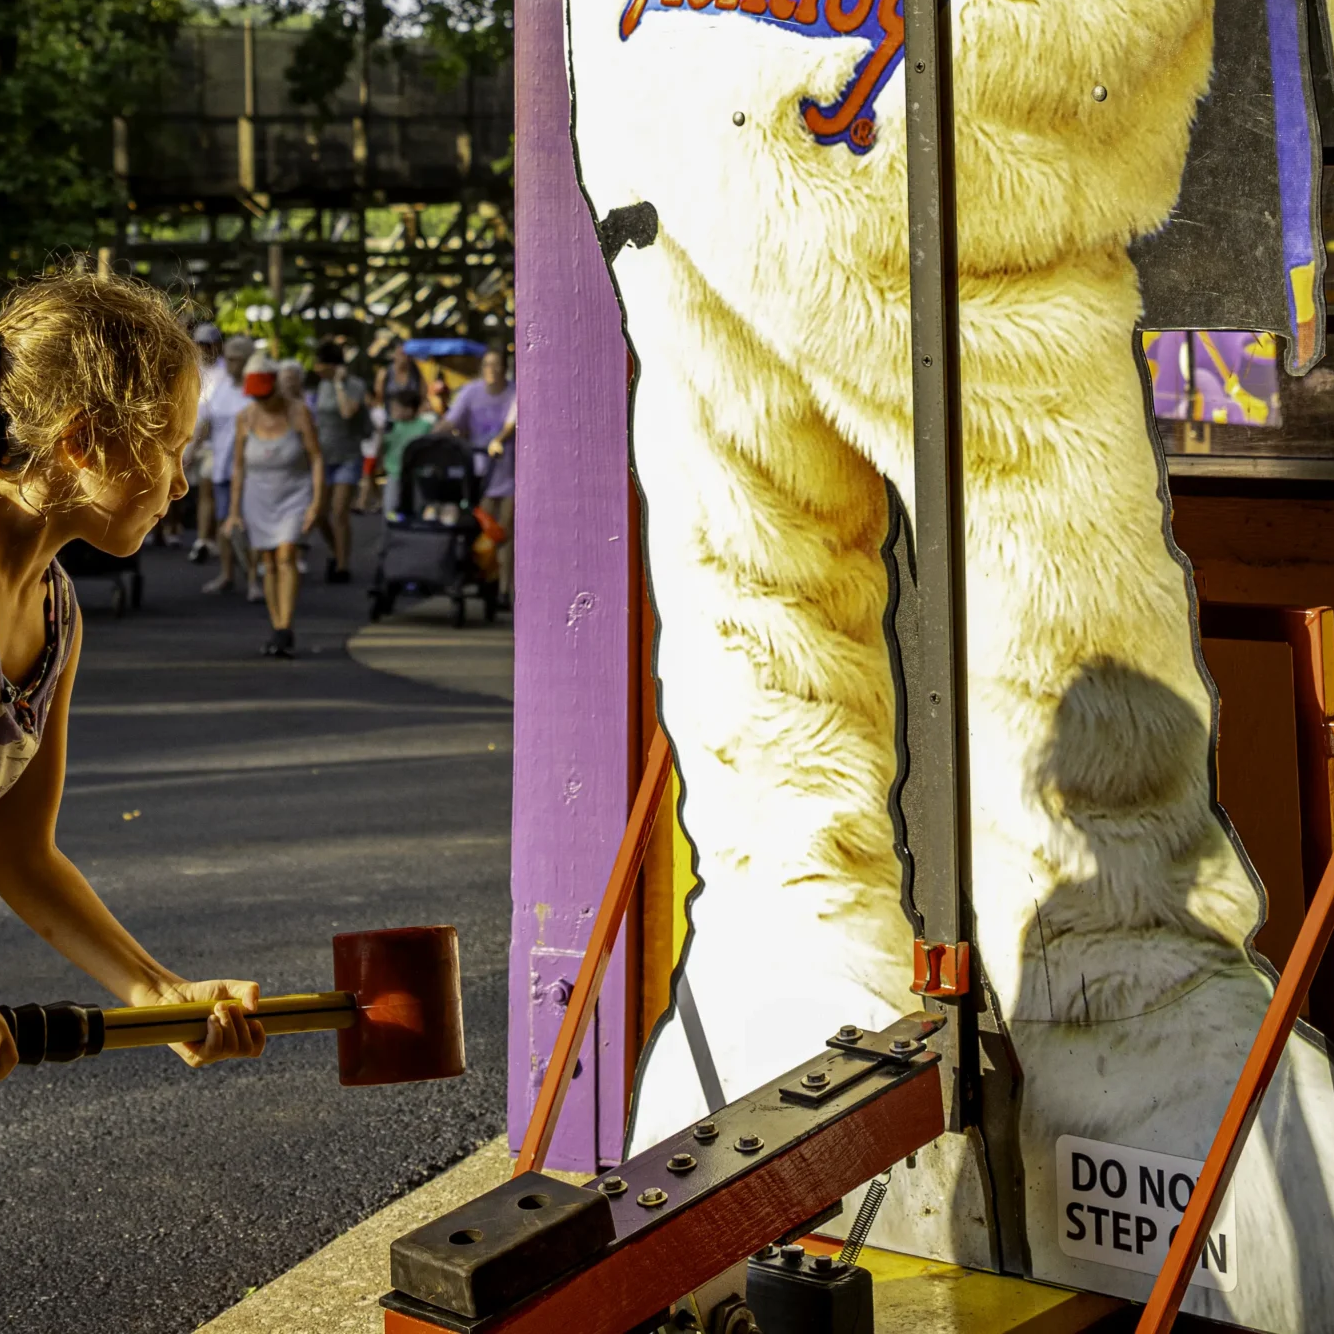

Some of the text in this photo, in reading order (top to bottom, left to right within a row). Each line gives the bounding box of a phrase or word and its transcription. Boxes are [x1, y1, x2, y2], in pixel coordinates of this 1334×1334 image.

[1071, 1152, 1201, 1214] DO NO
[1066, 1202, 1227, 1274] STEP N
